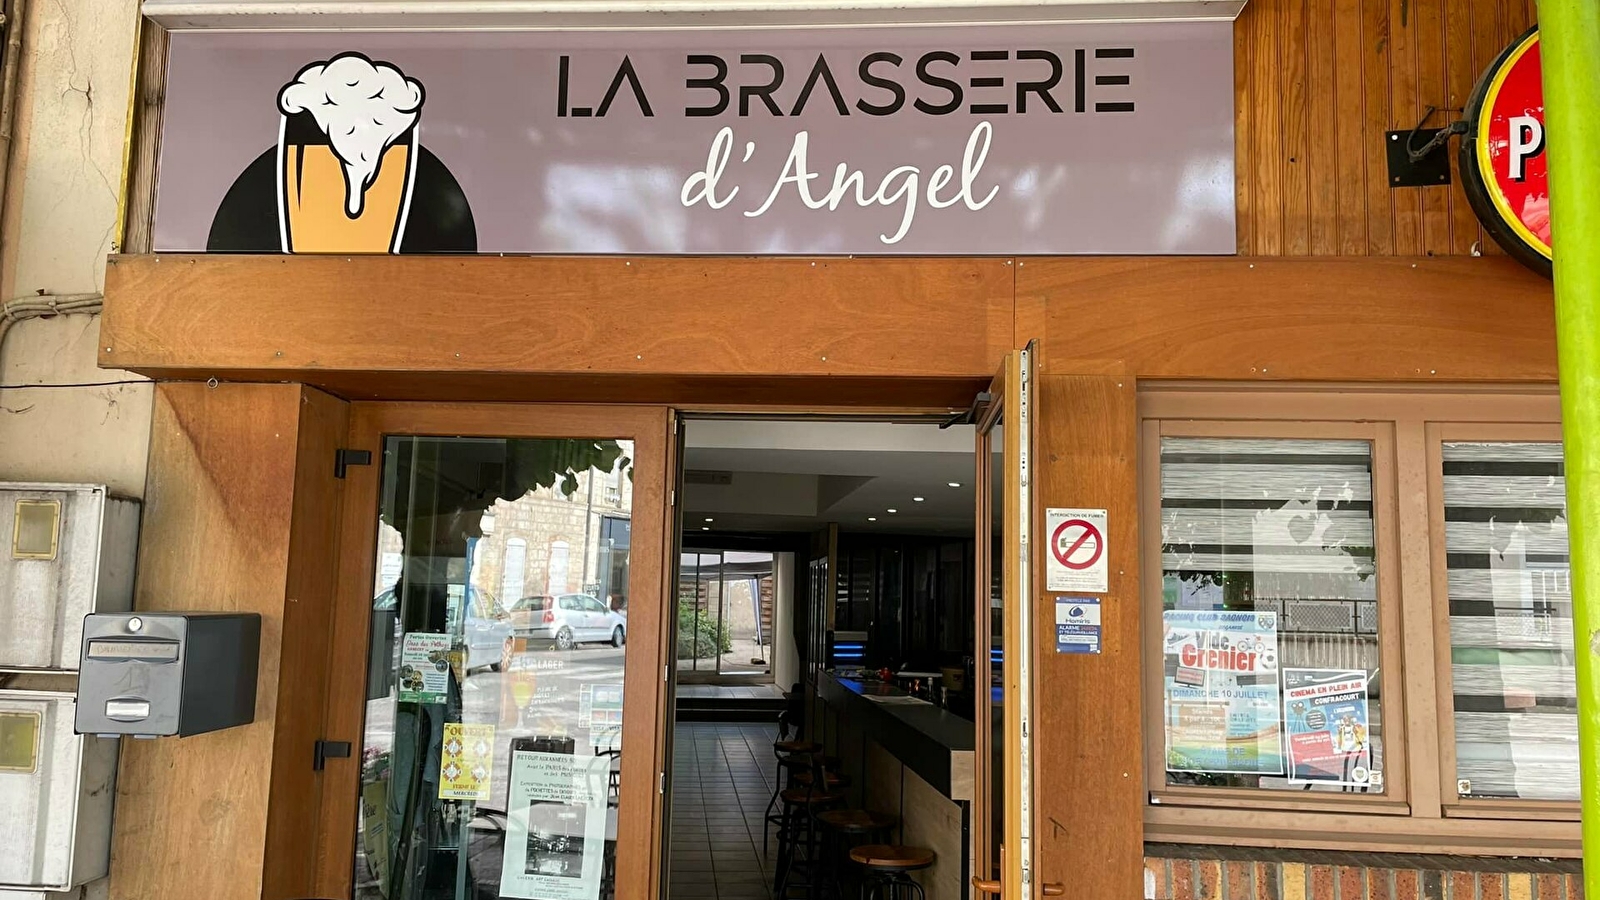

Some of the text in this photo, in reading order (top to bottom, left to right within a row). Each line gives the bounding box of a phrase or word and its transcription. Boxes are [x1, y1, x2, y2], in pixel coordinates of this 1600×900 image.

[557, 48, 1136, 117] LA BRASSERIE
[680, 121, 1000, 244] d'Angel
[1196, 613, 1218, 622] CLUB
[1195, 630, 1230, 651] Vide
[1182, 643, 1257, 671] Grenier
[1173, 689, 1269, 699] DIMANCHE 10 JUILLET
[1329, 684, 1348, 692] PLEIN
[1350, 681, 1362, 689] AIR
